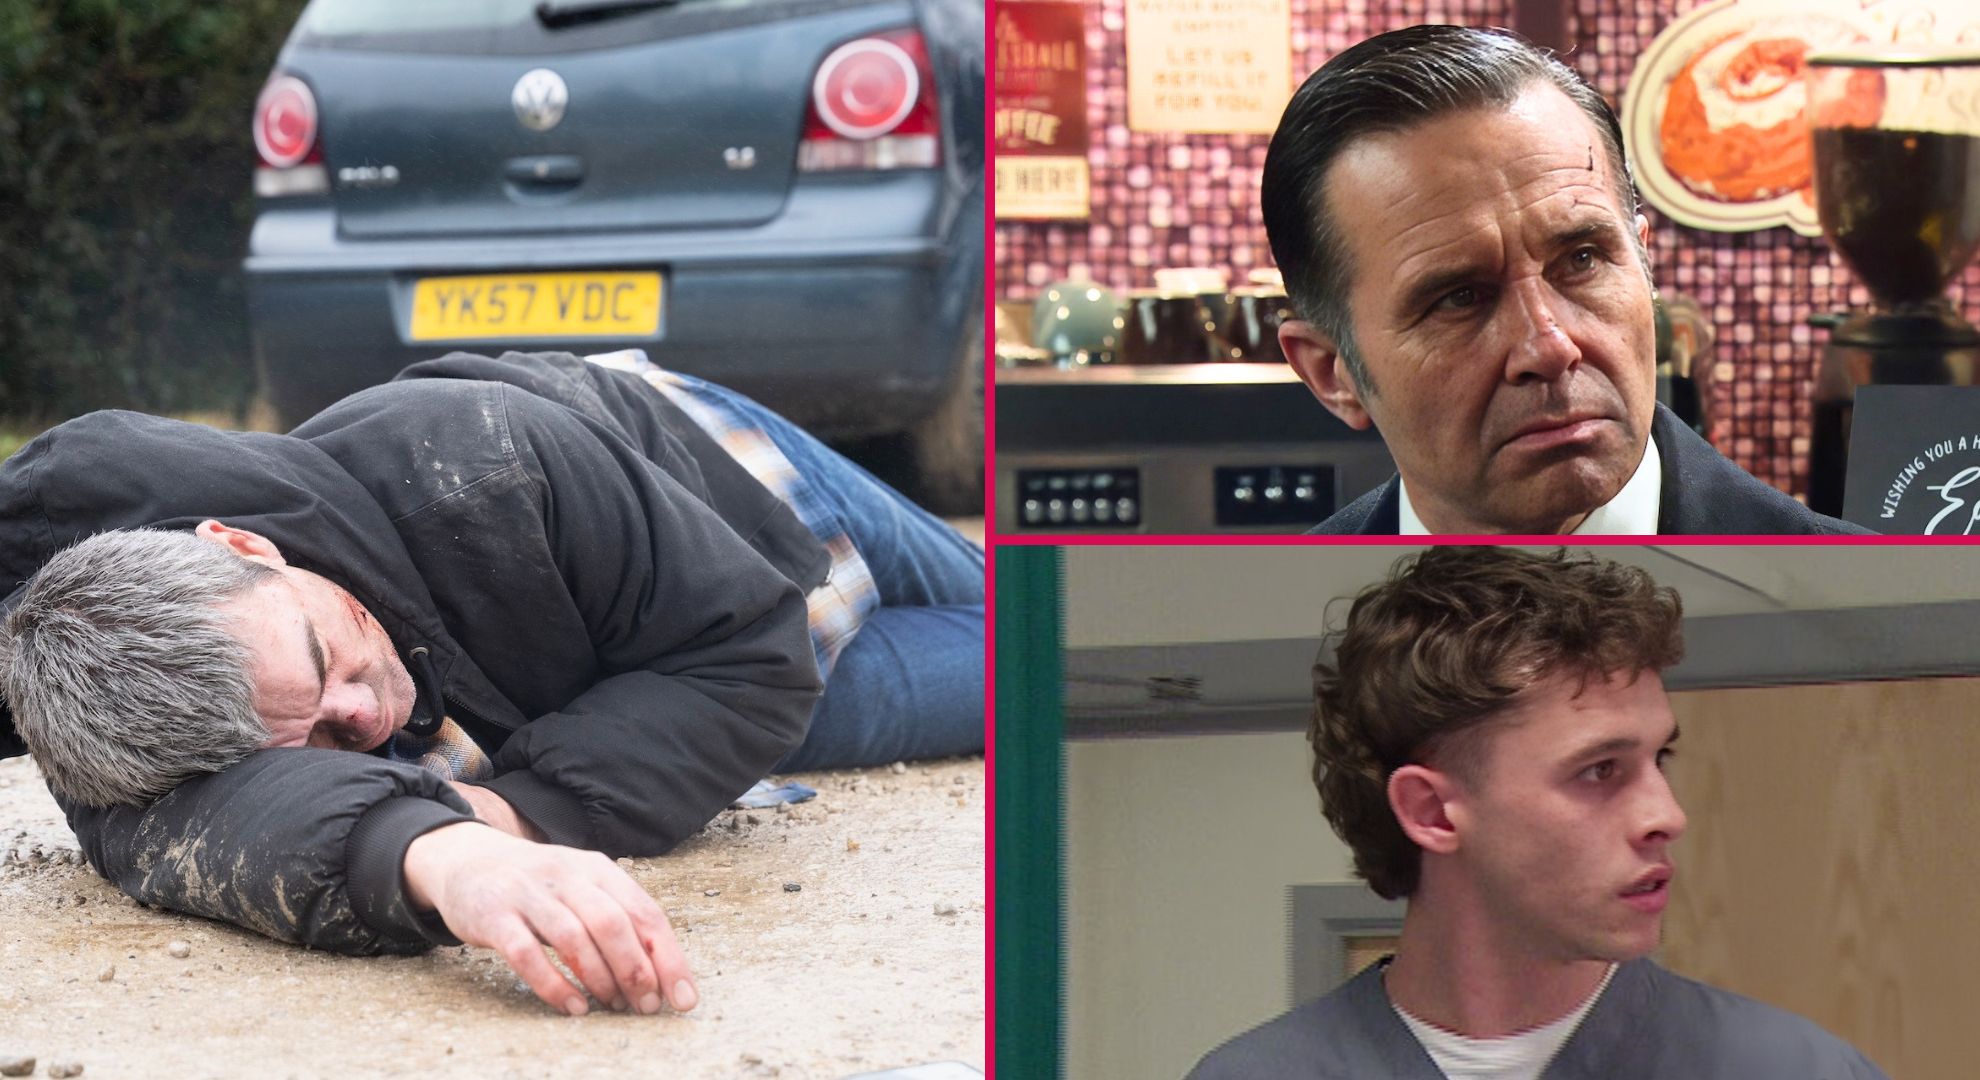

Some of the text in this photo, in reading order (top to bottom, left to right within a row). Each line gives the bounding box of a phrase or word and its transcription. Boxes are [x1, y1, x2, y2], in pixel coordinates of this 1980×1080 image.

[1166, 47, 1212, 65] LET
[434, 280, 637, 324] YK57 VDC
[1880, 456, 1926, 519] WISHING
[1924, 440, 1953, 463] YOU
[1958, 436, 1968, 451] A
